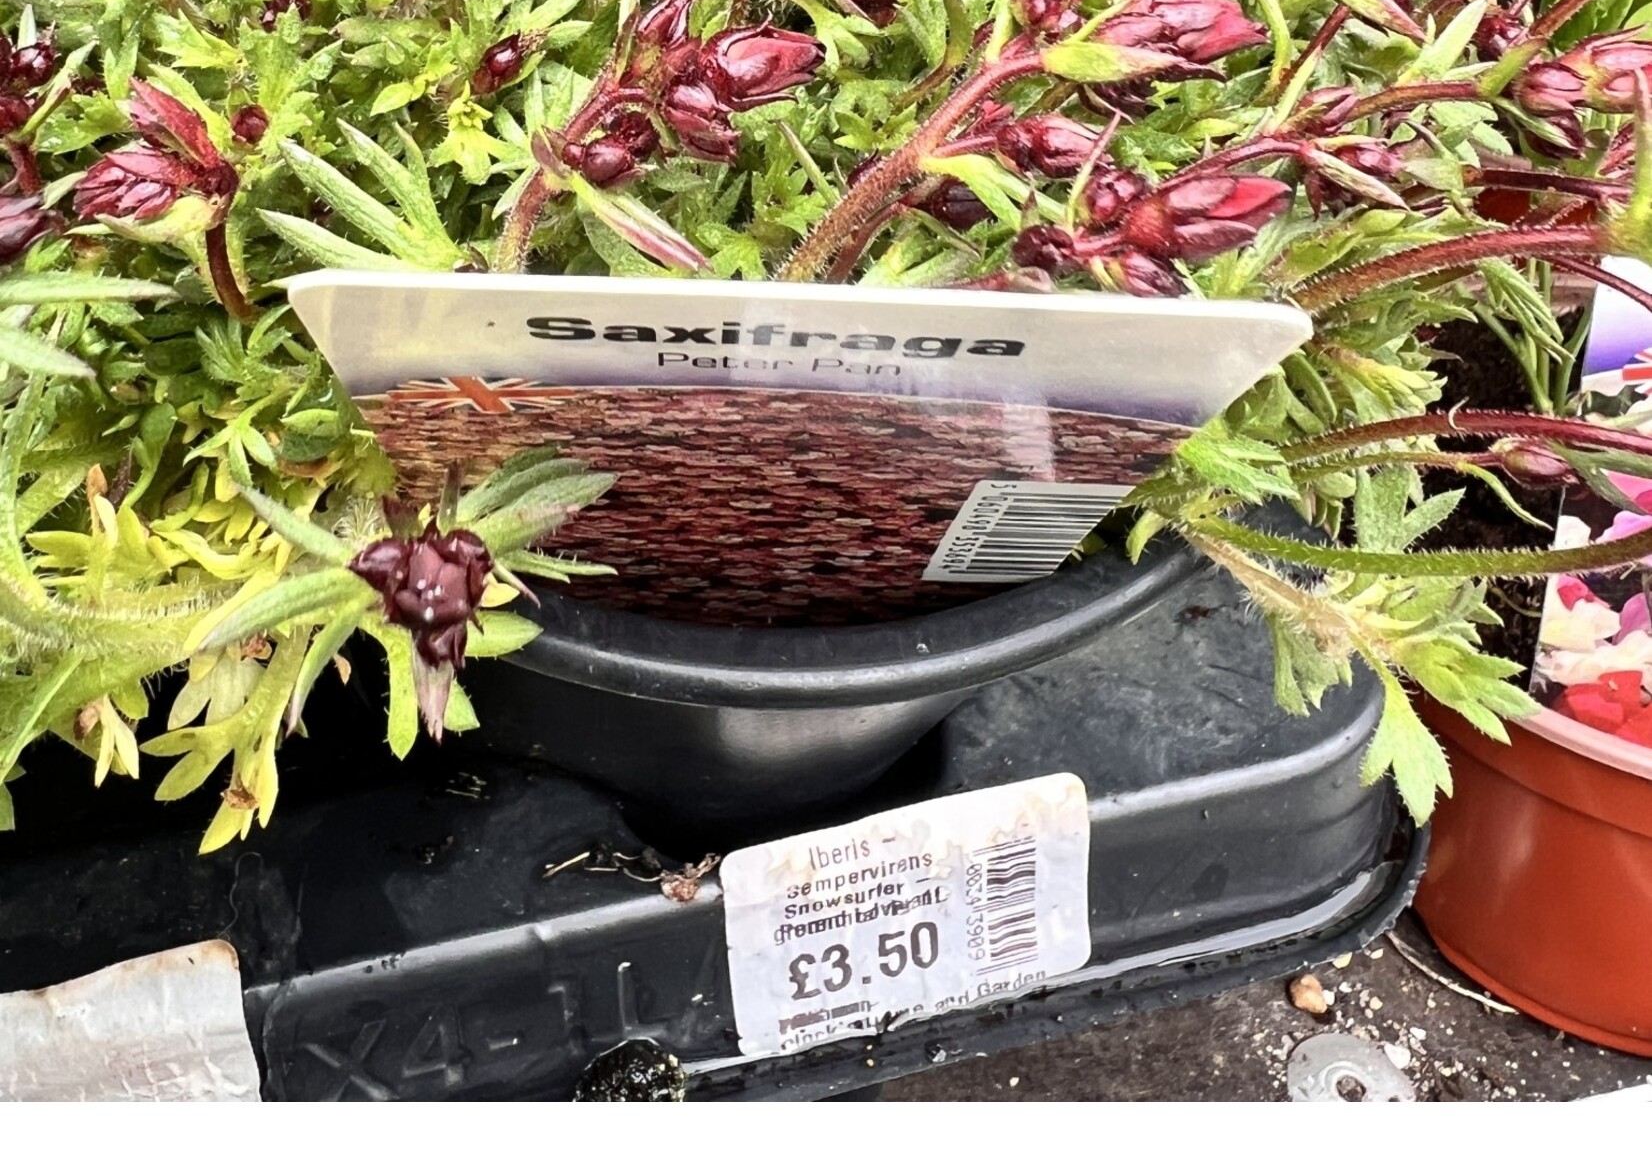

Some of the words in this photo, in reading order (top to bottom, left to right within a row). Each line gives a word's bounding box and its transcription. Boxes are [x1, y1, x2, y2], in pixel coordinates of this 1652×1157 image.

[526, 316, 1026, 359] Saxifraga
[657, 351, 794, 370] Peter
[811, 357, 901, 376] Pan
[808, 838, 871, 871] Iberis
[786, 852, 934, 900] Sempervirens
[784, 882, 904, 920] Snowsurfer
[788, 921, 939, 1001] £3.50
